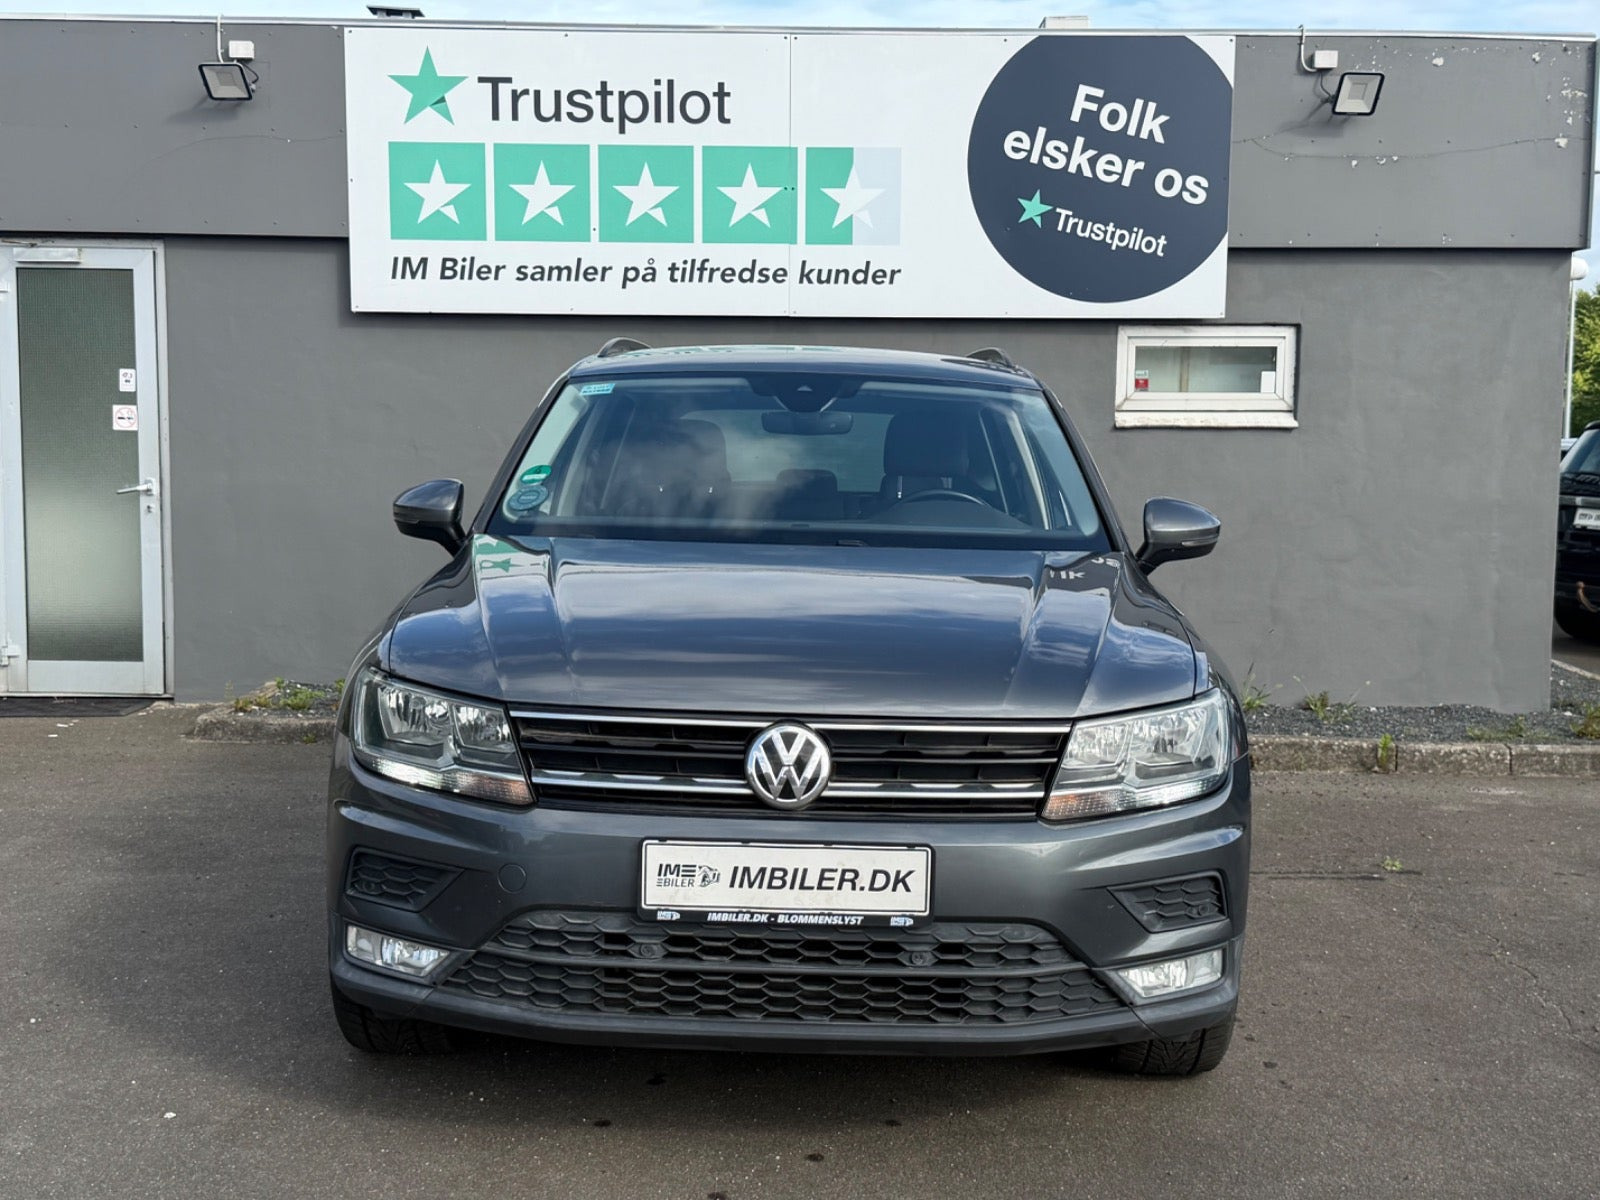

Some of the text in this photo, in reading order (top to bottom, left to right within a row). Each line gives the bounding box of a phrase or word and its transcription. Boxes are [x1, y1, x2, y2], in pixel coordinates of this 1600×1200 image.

[477, 76, 731, 134] Trustpilot
[1069, 83, 1170, 144] Folk
[1003, 126, 1209, 205] elsker os
[1055, 207, 1167, 257] Trustpilot
[390, 257, 902, 288] IM Biler samler på tilfredse kunder
[729, 865, 916, 893] IMBILER.DK
[706, 912, 769, 923] IMBILER.DK
[777, 914, 864, 925] BLOMMENSLYST
